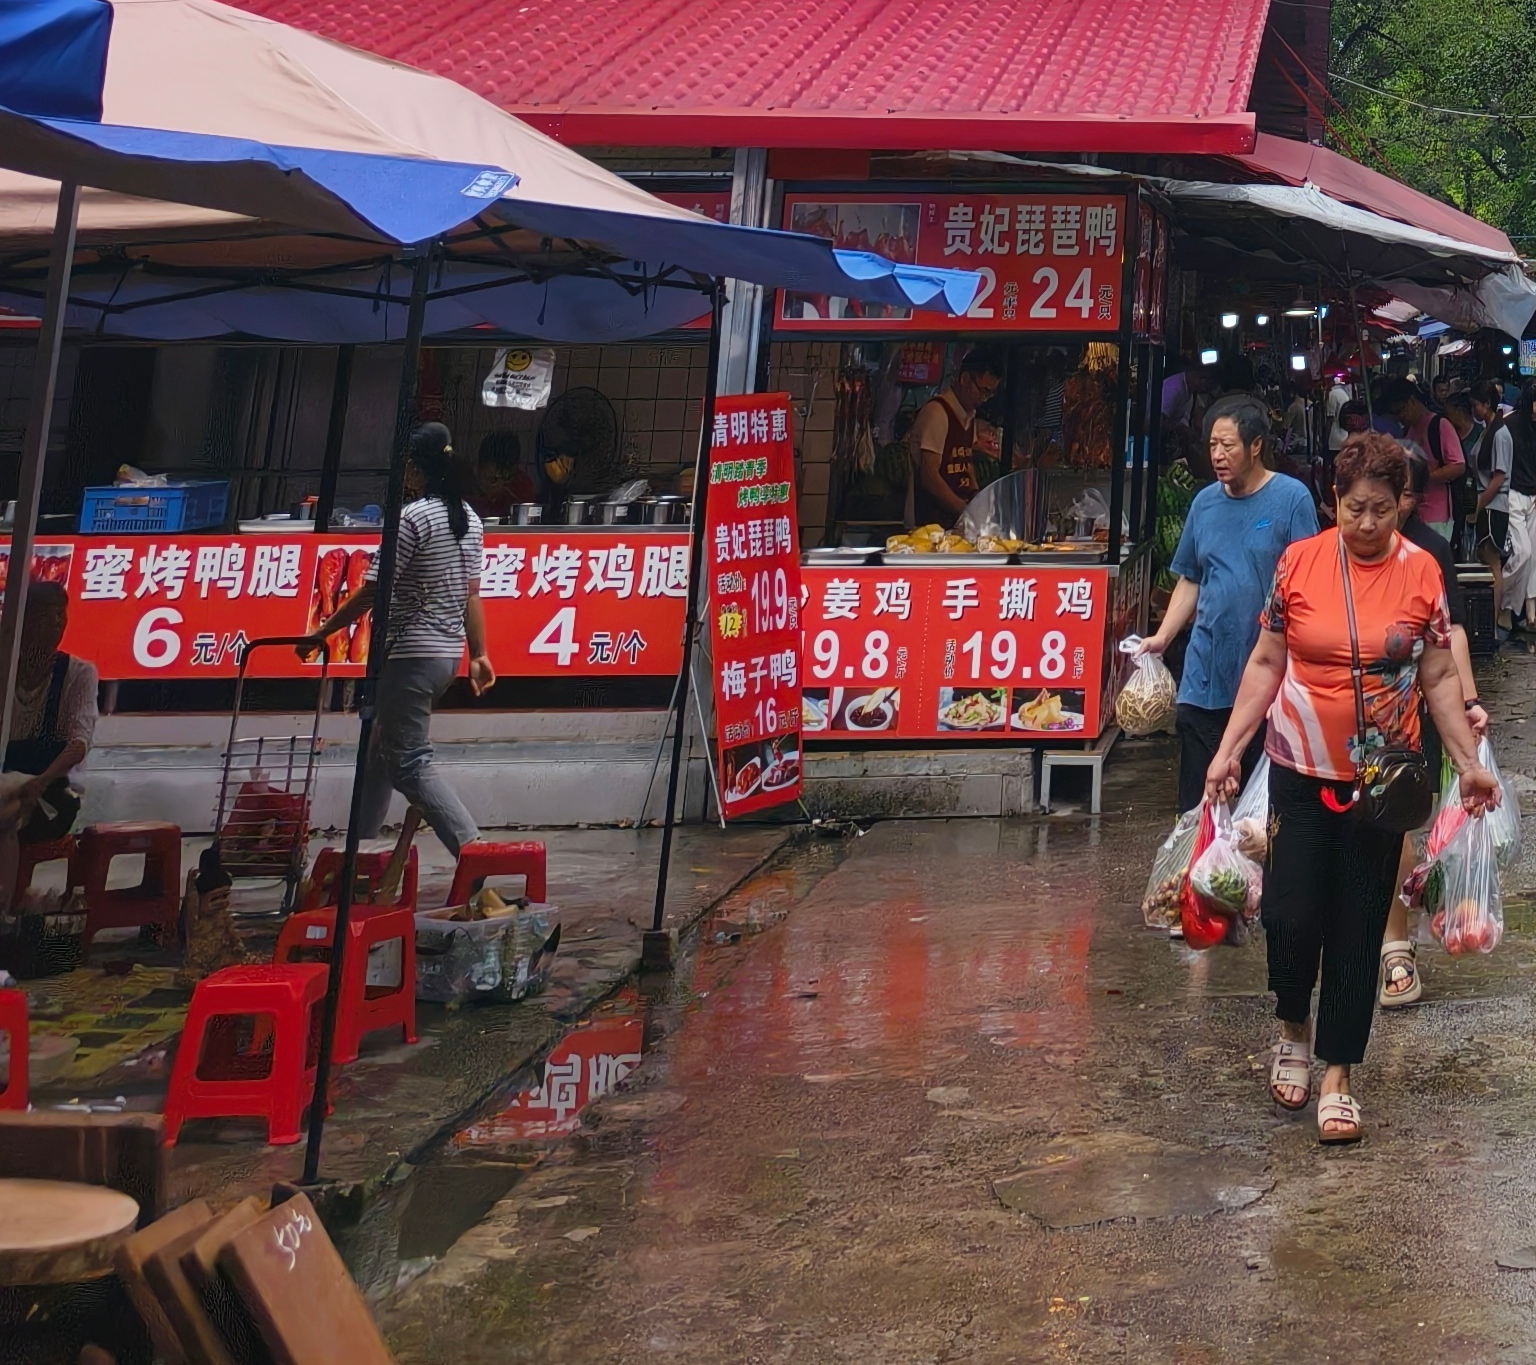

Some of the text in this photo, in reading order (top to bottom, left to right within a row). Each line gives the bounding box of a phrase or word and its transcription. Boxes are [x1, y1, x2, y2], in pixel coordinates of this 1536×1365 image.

[943, 203, 1117, 257] 贵妃琵琶鸭
[1029, 266, 1095, 318] 24
[712, 408, 788, 448] 清明特惠
[714, 515, 792, 563] 贵妃琵琶鸭
[81, 544, 303, 600] 蜜烤鸭腿
[479, 542, 690, 600] 蜜烤鸡腿
[942, 577, 1093, 621] 手撕鸡
[132, 607, 249, 668] 6 元/个
[529, 605, 647, 666] 4 元/个
[802, 629, 890, 679] 9.8
[962, 630, 1067, 679] 19.8
[721, 649, 797, 701] 梅子鸭
[755, 697, 777, 736] 16
